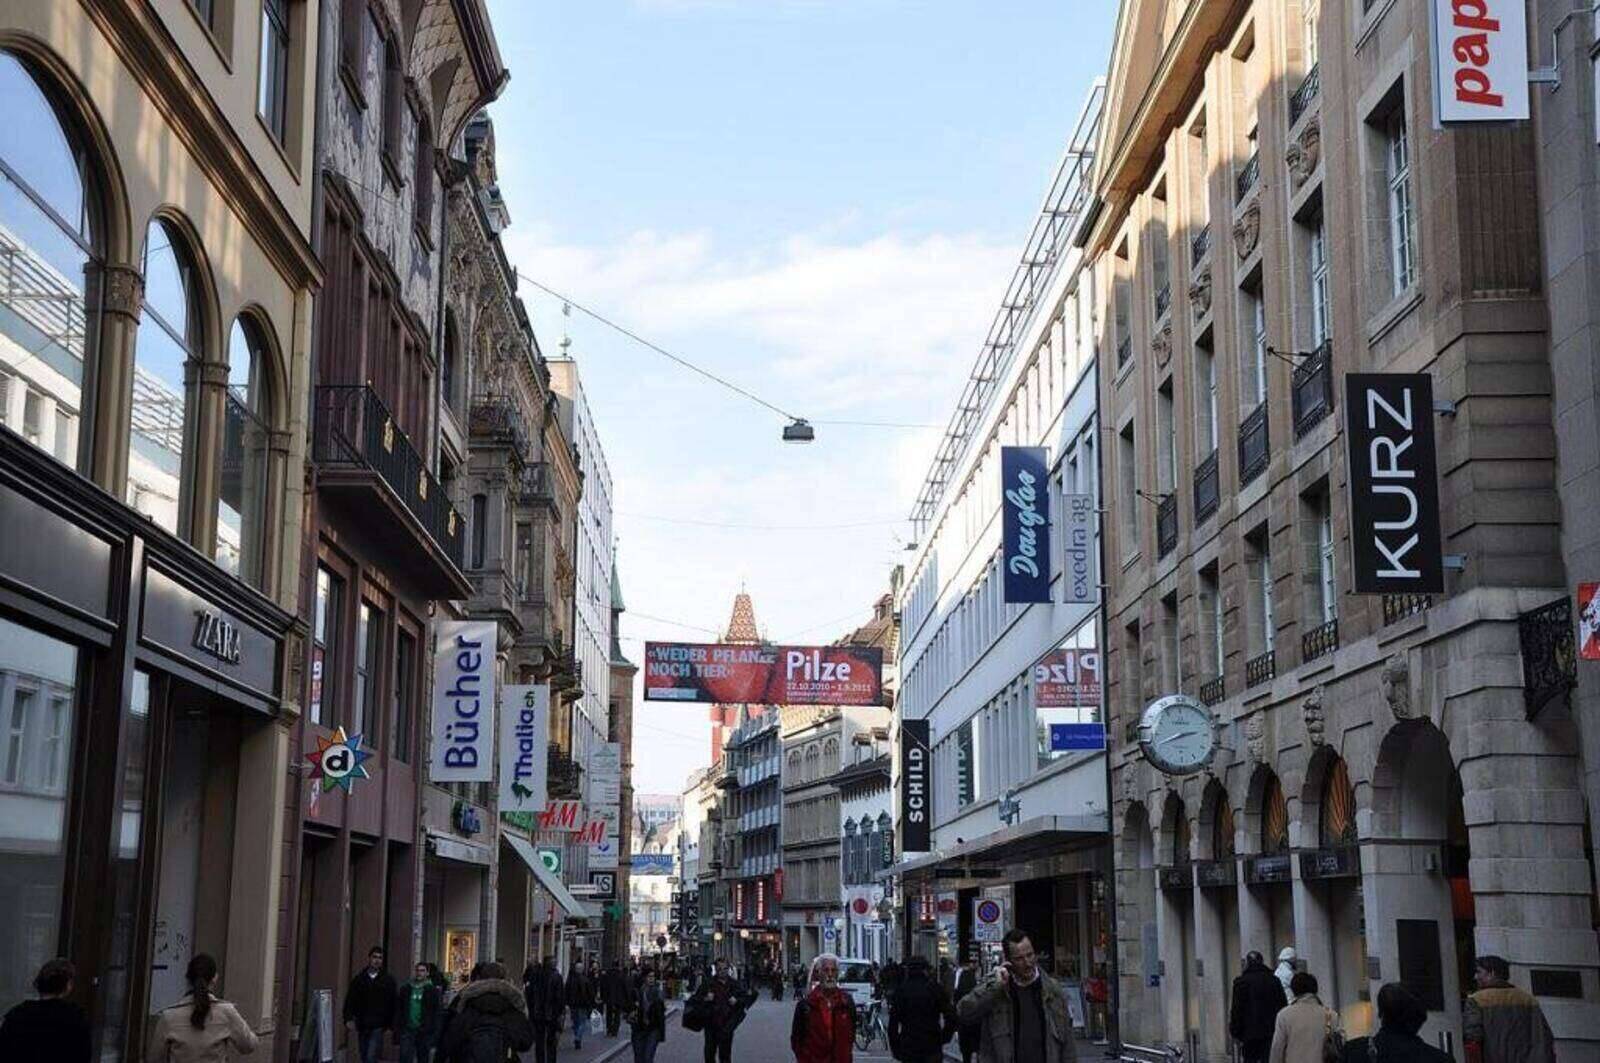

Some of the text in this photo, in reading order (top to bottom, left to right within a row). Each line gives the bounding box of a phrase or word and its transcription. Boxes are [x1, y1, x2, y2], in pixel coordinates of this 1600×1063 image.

[1451, 0, 1503, 107] pap
[1005, 469, 1045, 578] Douglas
[1366, 388, 1421, 578] KURZ
[1064, 497, 1094, 599] exedra ag
[193, 610, 241, 663] ZARA
[649, 662, 690, 677] NOCH
[786, 650, 851, 681] Pilze
[444, 634, 482, 768] Bücher
[326, 750, 349, 771] d
[909, 747, 924, 823] SCHILD
